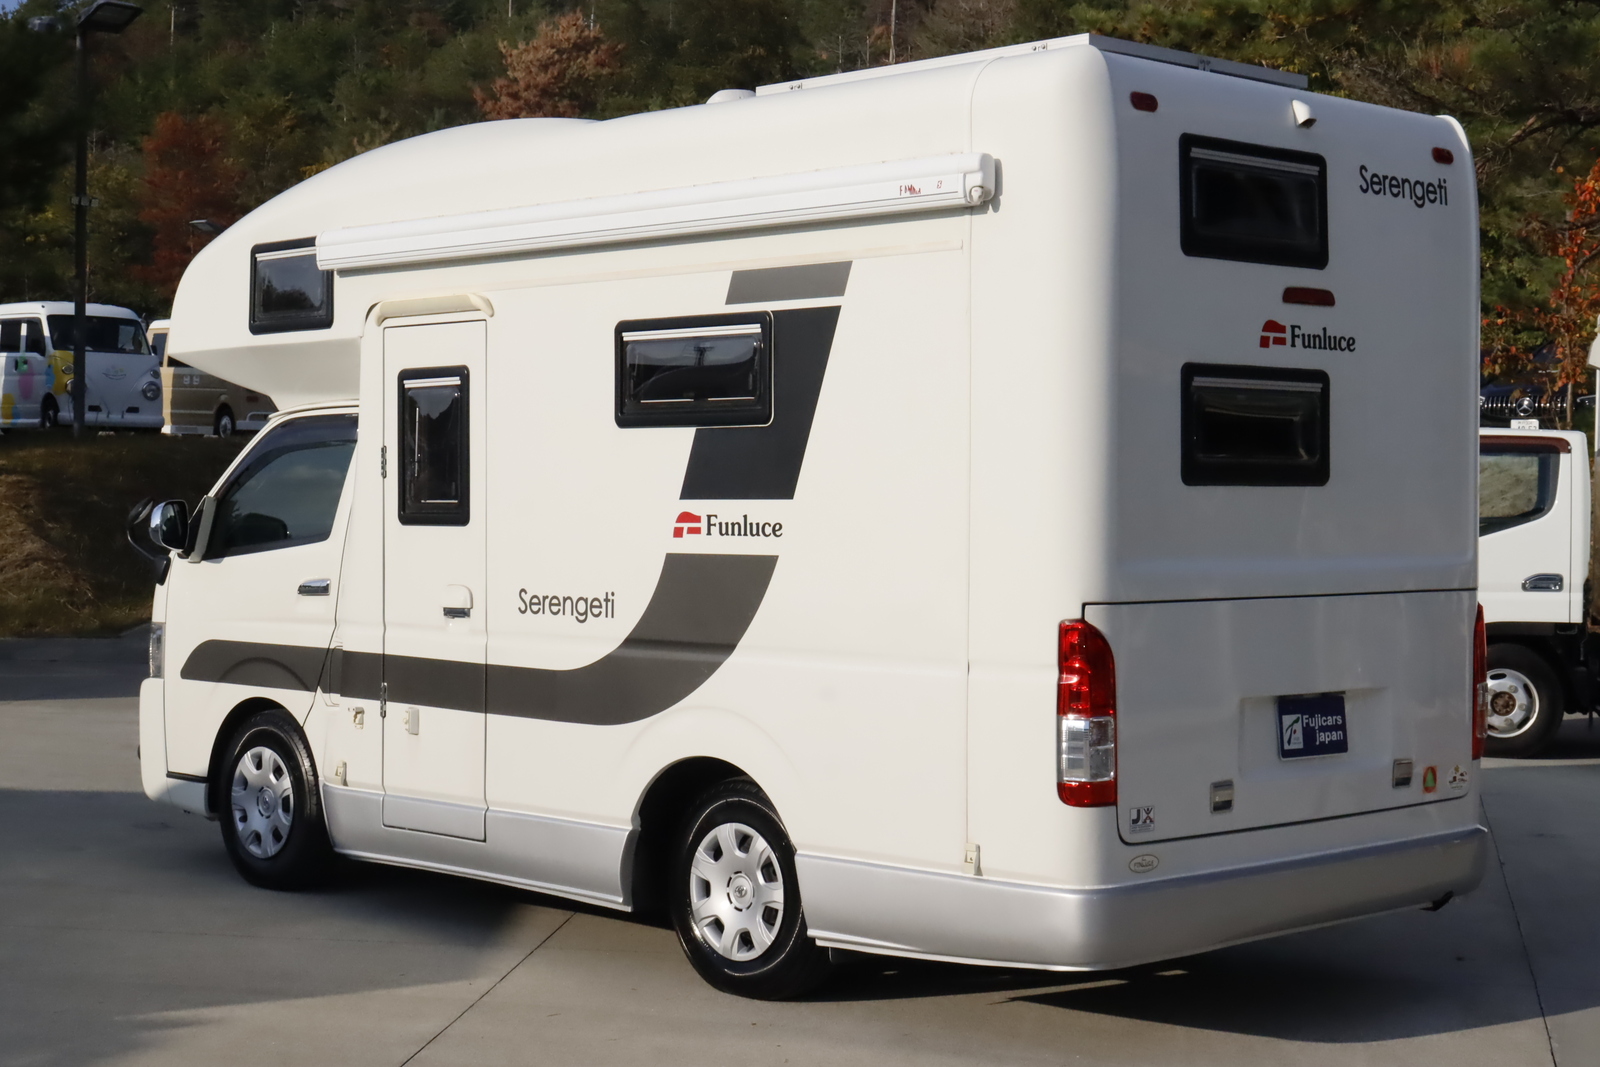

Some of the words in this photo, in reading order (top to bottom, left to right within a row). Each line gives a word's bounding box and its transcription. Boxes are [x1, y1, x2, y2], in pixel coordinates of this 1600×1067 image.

[1359, 165, 1448, 208] Serengeti
[1290, 325, 1356, 352] Funluce
[706, 515, 783, 538] Funluce
[518, 588, 615, 623] Serengeti
[1303, 714, 1343, 729] Fujicars
[1315, 730, 1343, 746] japan
